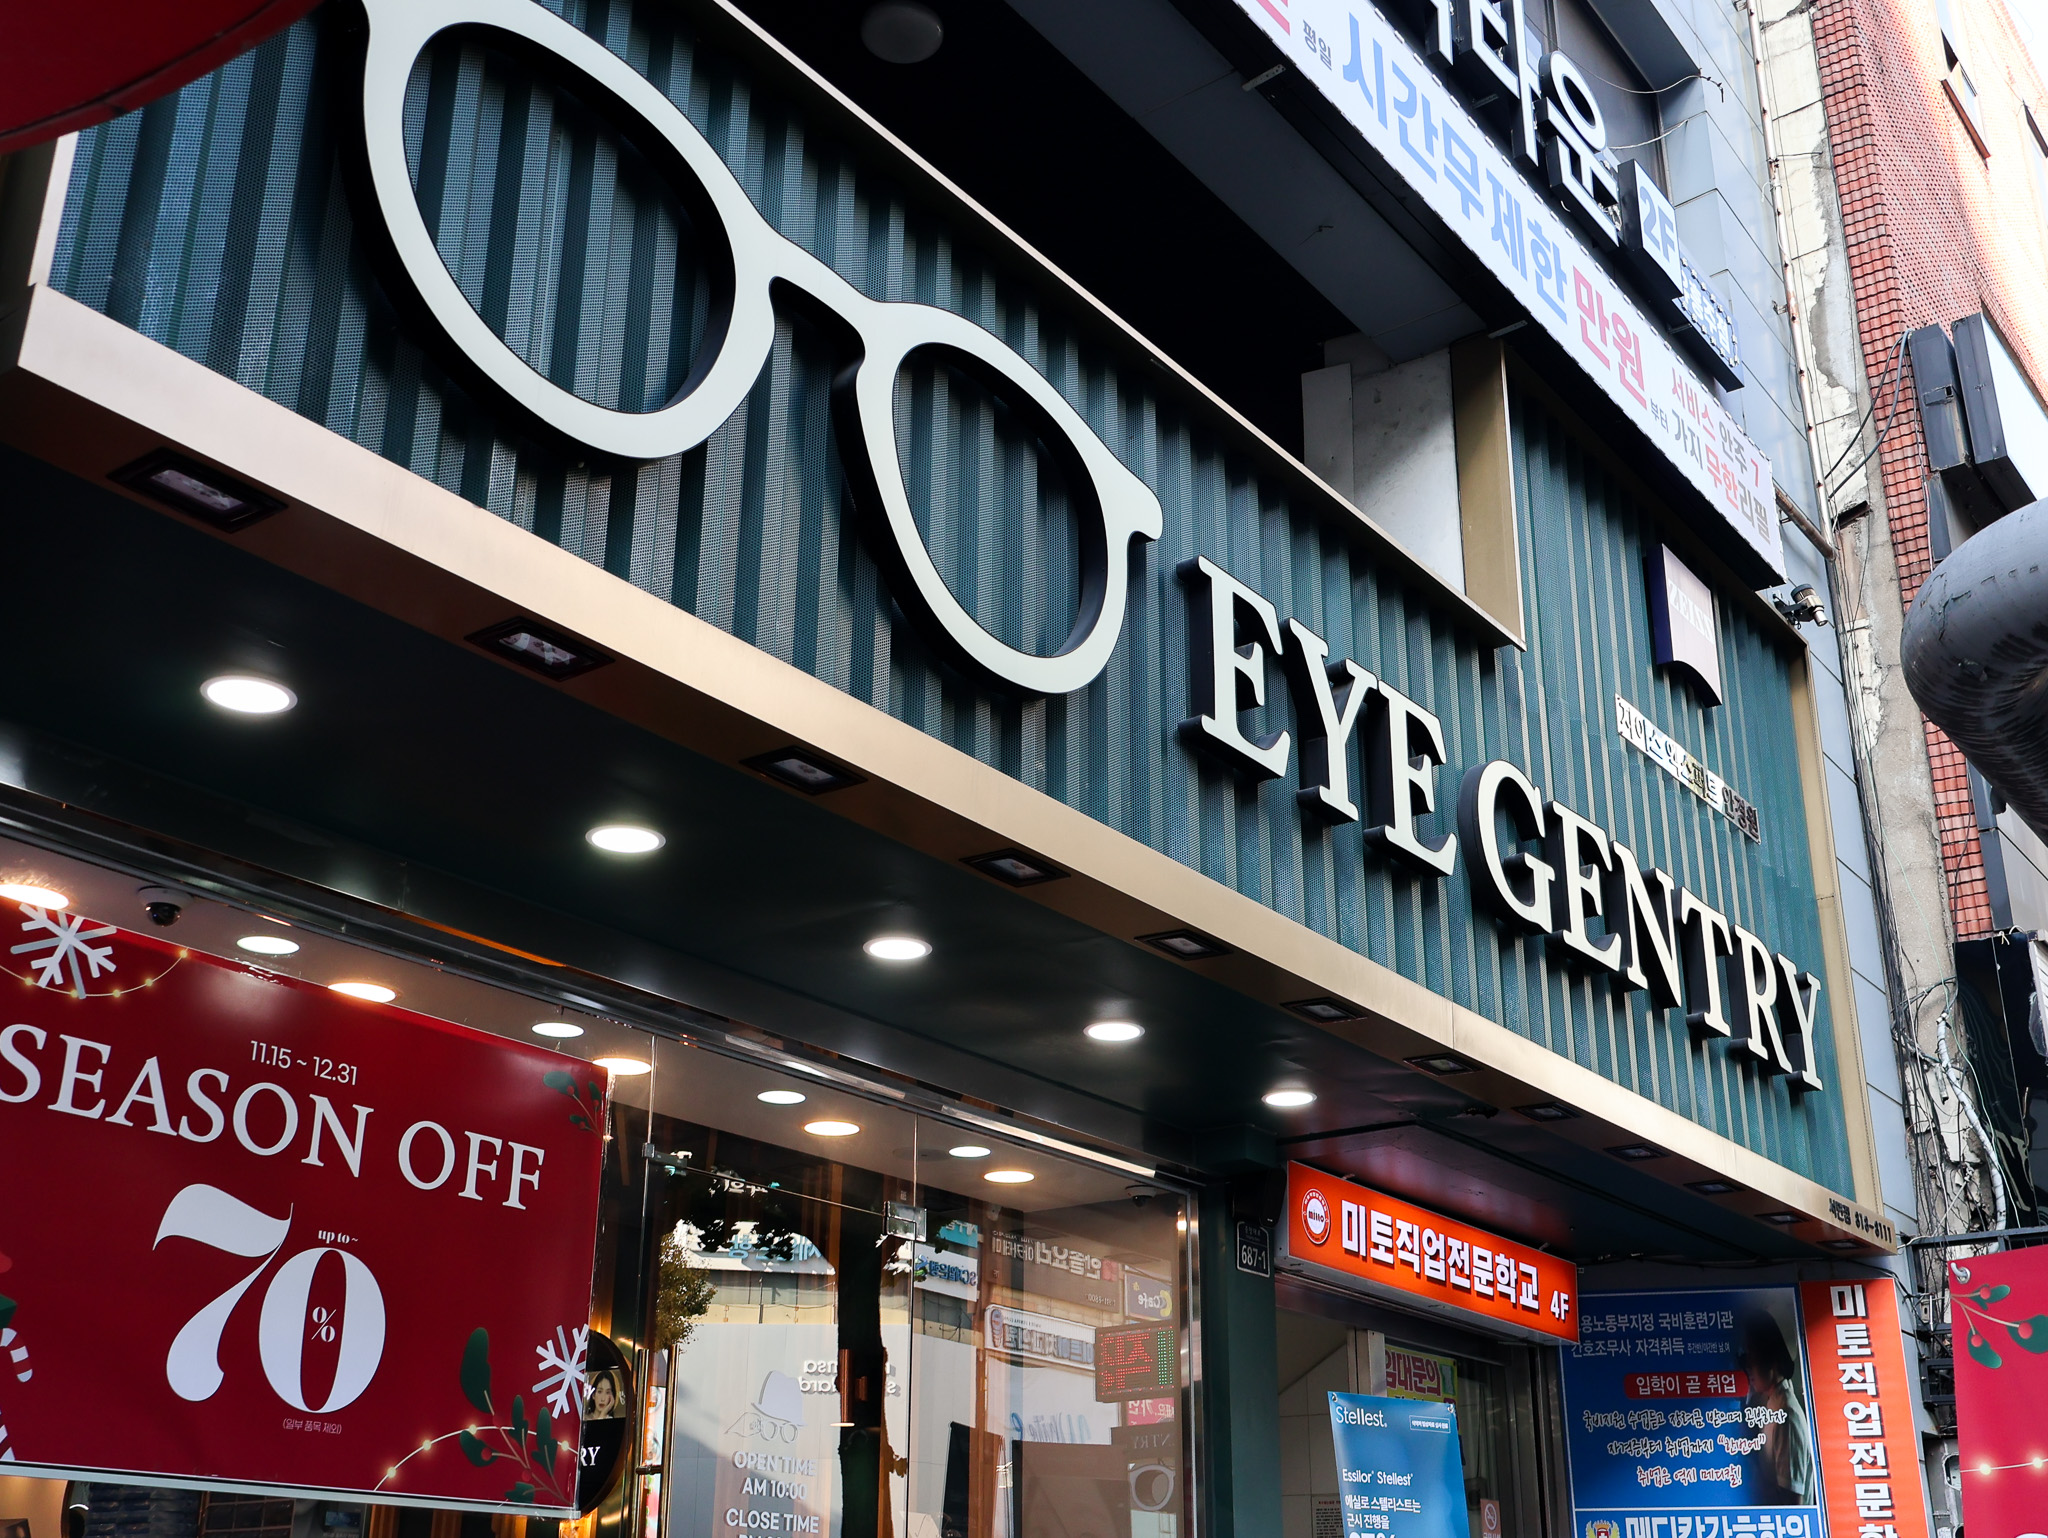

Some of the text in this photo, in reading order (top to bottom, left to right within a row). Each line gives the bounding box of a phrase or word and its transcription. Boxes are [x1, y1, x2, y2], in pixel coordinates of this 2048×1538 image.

[1302, 11, 1670, 434] 평일 시간무제한 만원 부터
[1639, 185, 1676, 263] 2F
[1671, 367, 1760, 488] 서비스 안주 7
[1671, 409, 1771, 545] 가지 무한리필
[1667, 577, 1716, 645] ZEISS
[1197, 555, 1823, 1092] EYE GENTRY
[1721, 787, 1759, 839] 안경원
[250, 1040, 291, 1069] 11.15
[313, 1056, 358, 1086] 12.31
[0, 1023, 546, 1210] SEASON OFF
[318, 1229, 335, 1243] up
[1241, 1244, 1266, 1270] 687-1
[1341, 1199, 1570, 1321] 미토직업전문학교 4F
[152, 1183, 387, 1415] 70
[1578, 1310, 1734, 1334] 용노동부지정 국비훈련기관
[1571, 1341, 1631, 1359] 간호조무사
[1635, 1337, 1685, 1357] 자격취득
[1636, 1373, 1736, 1395] 입학이 곧 취업
[282, 1417, 343, 1435] (일부 품목 제외)
[1583, 1409, 1626, 1432] 국비지원
[1744, 1406, 1787, 1429] 공부하자
[1607, 1437, 1663, 1459] 자격증부터
[1664, 1436, 1714, 1458] 취업까지
[732, 1450, 817, 1477] OPEN TIME
[1636, 1465, 1672, 1488] 취업은
[1673, 1466, 1698, 1487] 역시
[741, 1477, 808, 1500] AM 10:00
[1344, 1494, 1421, 1513] 에실로 스텔리스트는
[725, 1508, 820, 1534] CLOSE TIME
[1346, 1512, 1363, 1528] 근시
[1363, 1513, 1391, 1530] 진행을
